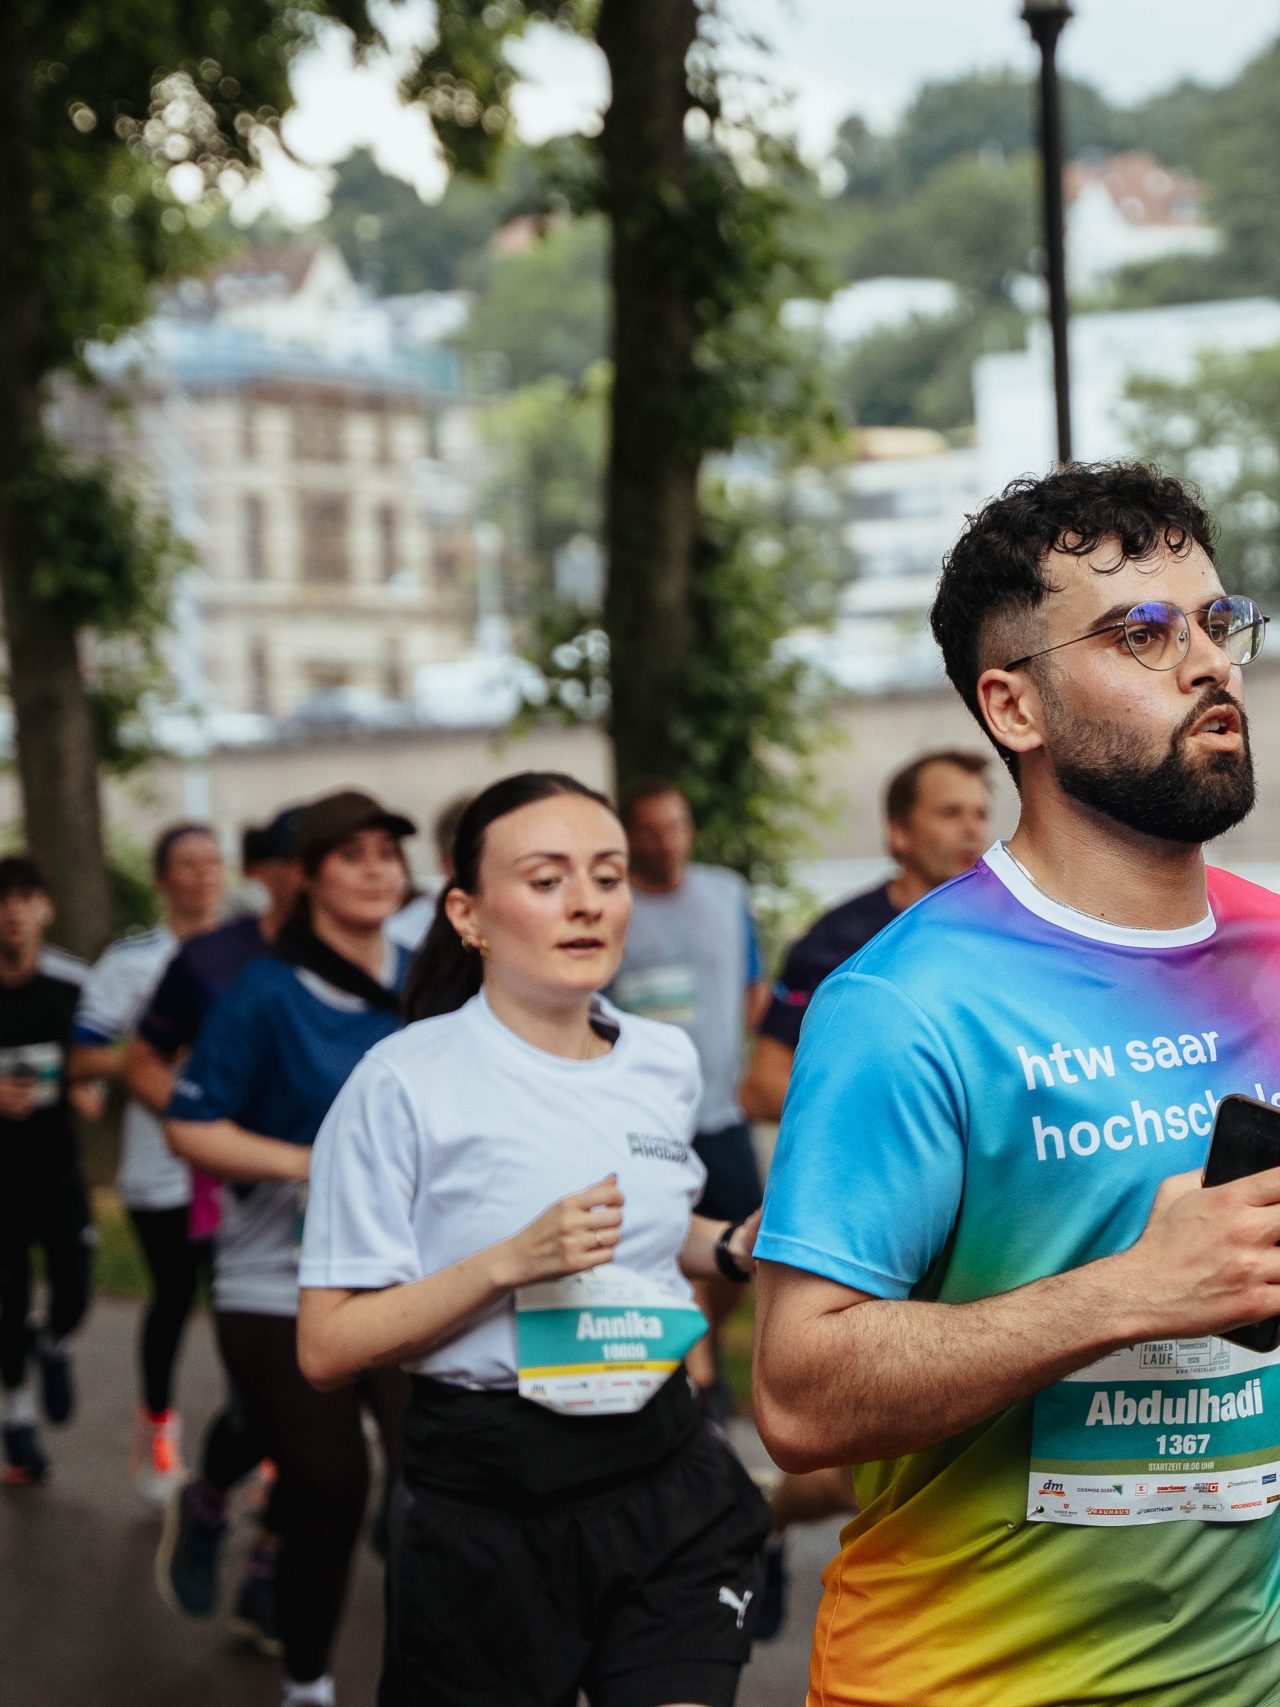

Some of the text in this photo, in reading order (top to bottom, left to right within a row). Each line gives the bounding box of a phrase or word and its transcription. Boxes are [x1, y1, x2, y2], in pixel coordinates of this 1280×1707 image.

[1016, 1030, 1220, 1091] htw saar
[576, 1310, 663, 1341] Annika
[1144, 1342, 1174, 1353] FIRMEN
[1143, 1353, 1174, 1366] LAUF
[1085, 1378, 1264, 1427] Abdulhadi
[1156, 1433, 1211, 1455] 1367
[1148, 1462, 1182, 1472] STARTZEIT
[1201, 1461, 1215, 1471] UHR
[1043, 1479, 1064, 1491] dm
